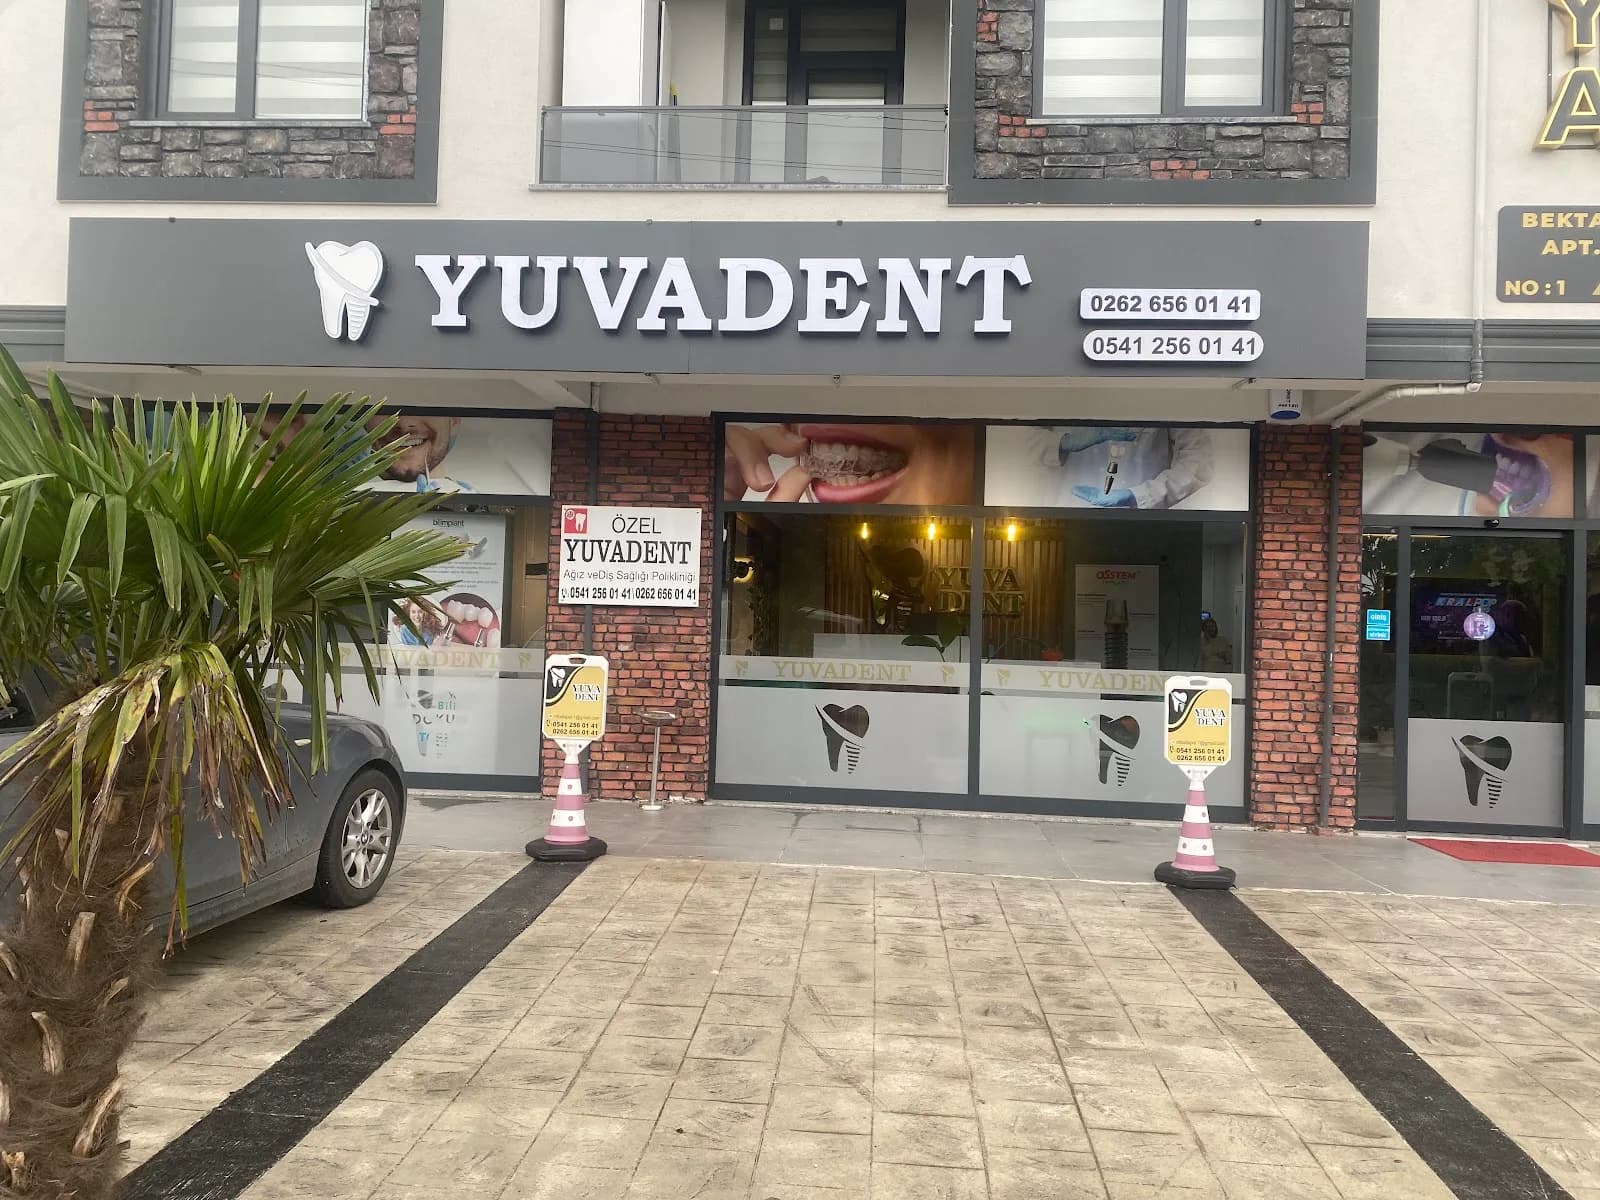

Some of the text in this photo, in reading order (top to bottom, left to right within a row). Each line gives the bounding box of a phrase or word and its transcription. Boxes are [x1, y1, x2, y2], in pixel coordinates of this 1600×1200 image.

[1542, 239, 1600, 255] APT.
[415, 255, 1032, 333] YUVADENT
[1091, 295, 1251, 313] 0262 656 01 41
[1092, 337, 1256, 355] 0541 256 01 41
[612, 513, 662, 534] ÖZEL
[564, 539, 692, 564] YUVADENT
[563, 569, 585, 580] Ağız
[616, 571, 649, 582] Sağlığı
[570, 587, 697, 600] 0541 256 01 41 0262 656 01 41
[772, 660, 912, 681] YUVADENT
[573, 684, 601, 693] YUVA
[1038, 669, 1168, 692] YUVADEN
[575, 693, 600, 701] DENT
[1195, 708, 1226, 717] YUVA
[1198, 718, 1225, 726] DENT
